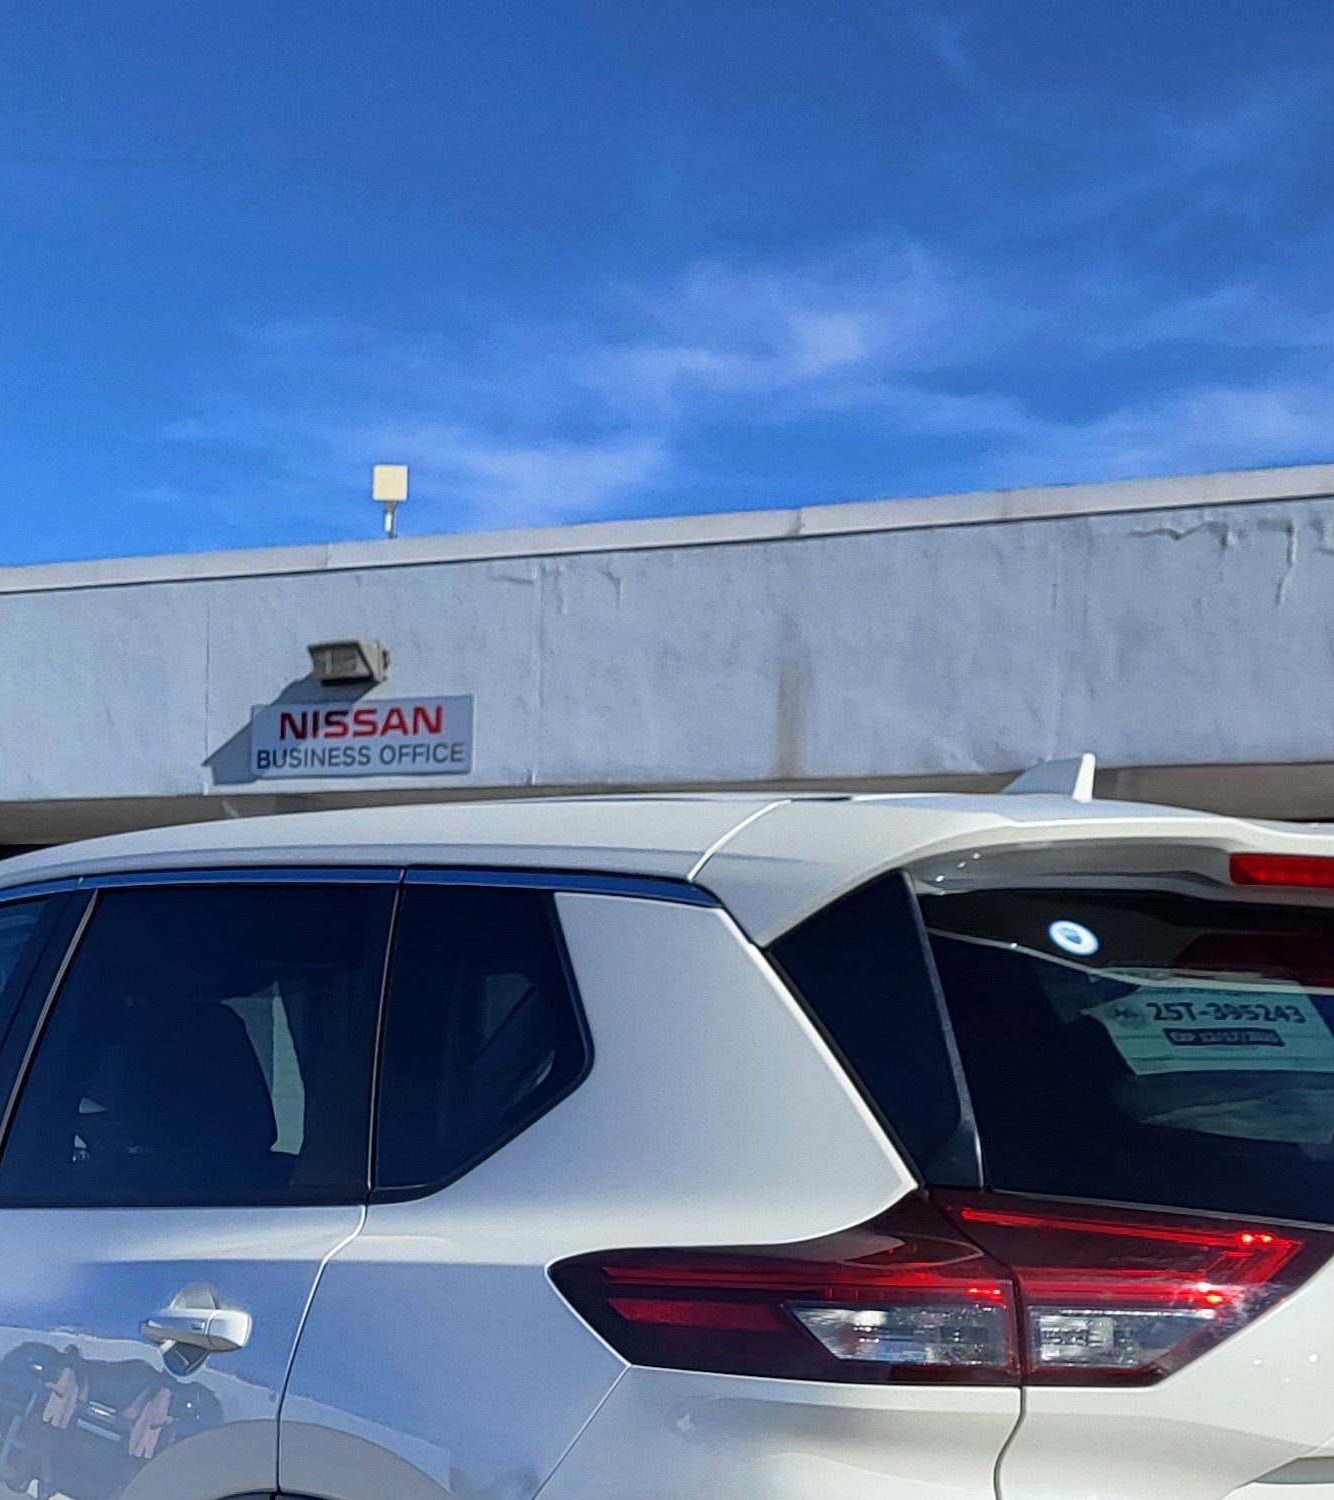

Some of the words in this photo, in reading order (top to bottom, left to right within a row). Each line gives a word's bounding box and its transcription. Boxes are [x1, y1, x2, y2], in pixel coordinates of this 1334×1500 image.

[279, 706, 443, 741] NISSAN
[257, 746, 371, 770] BUSINESS
[379, 742, 465, 765] OFFICE
